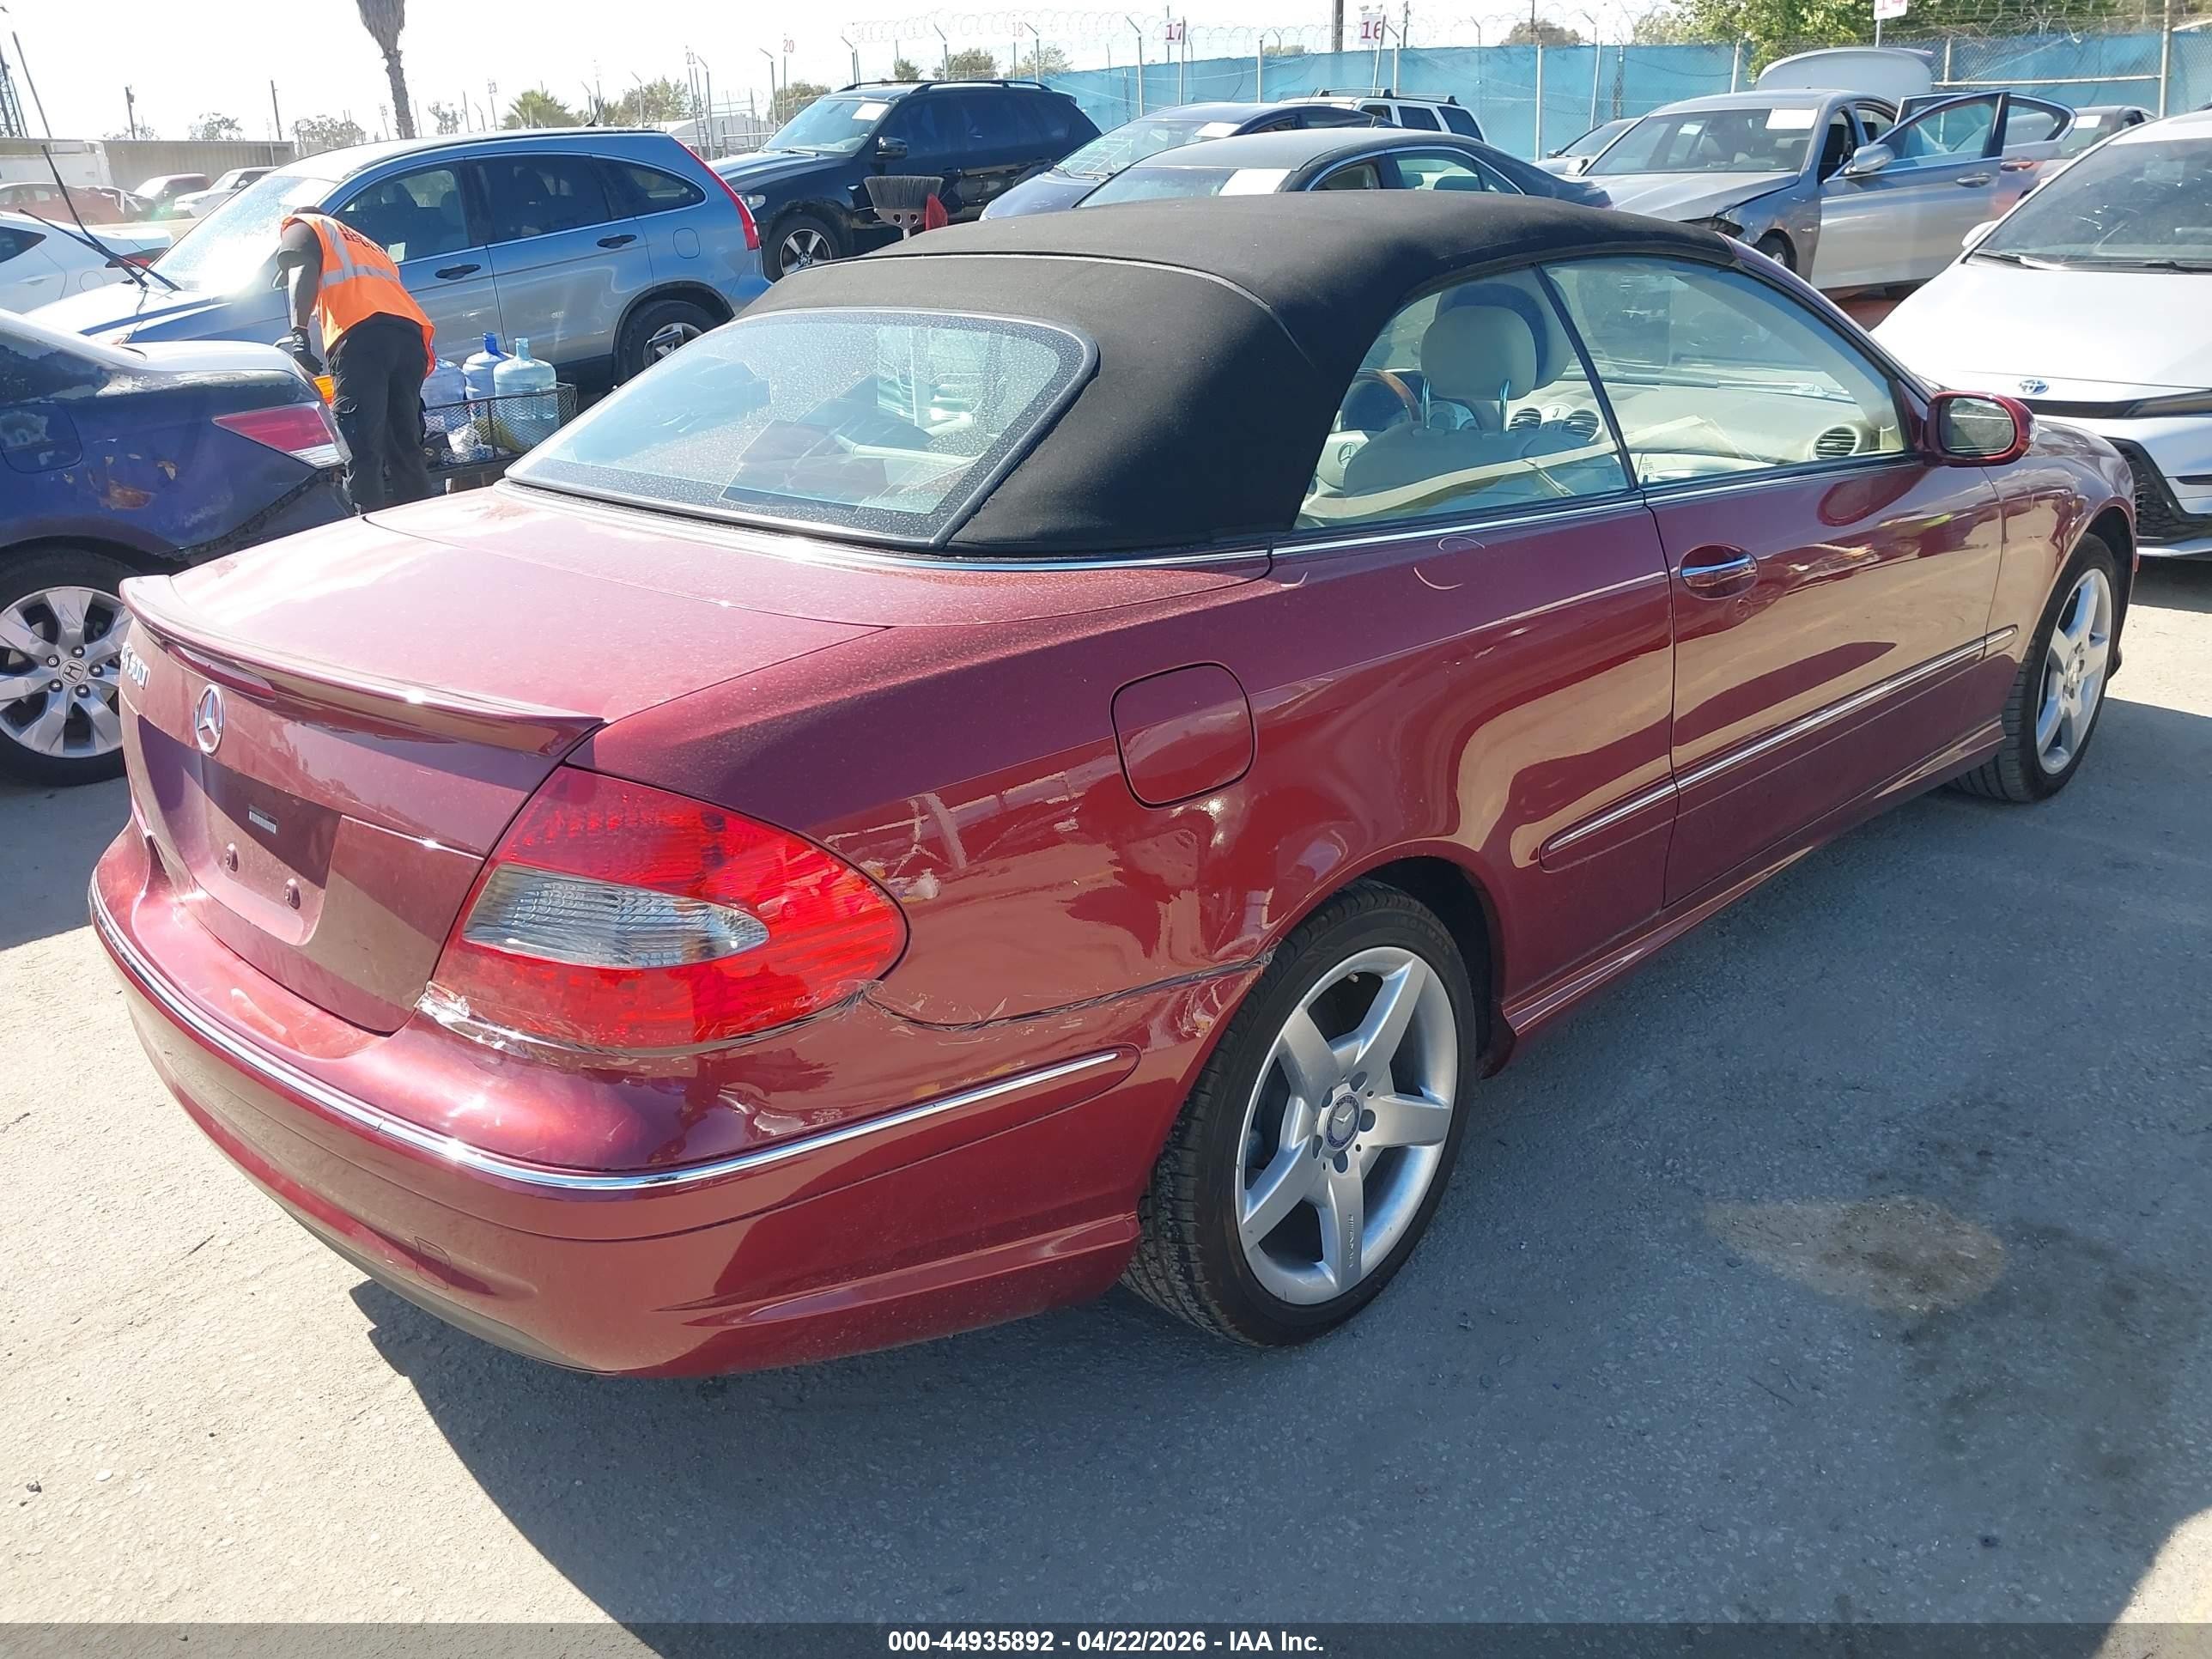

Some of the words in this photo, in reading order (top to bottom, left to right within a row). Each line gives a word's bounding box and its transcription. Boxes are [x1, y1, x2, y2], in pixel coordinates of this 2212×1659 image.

[1165, 23, 1182, 40] 17
[1360, 21, 1382, 40] 16
[782, 39, 794, 52] 20
